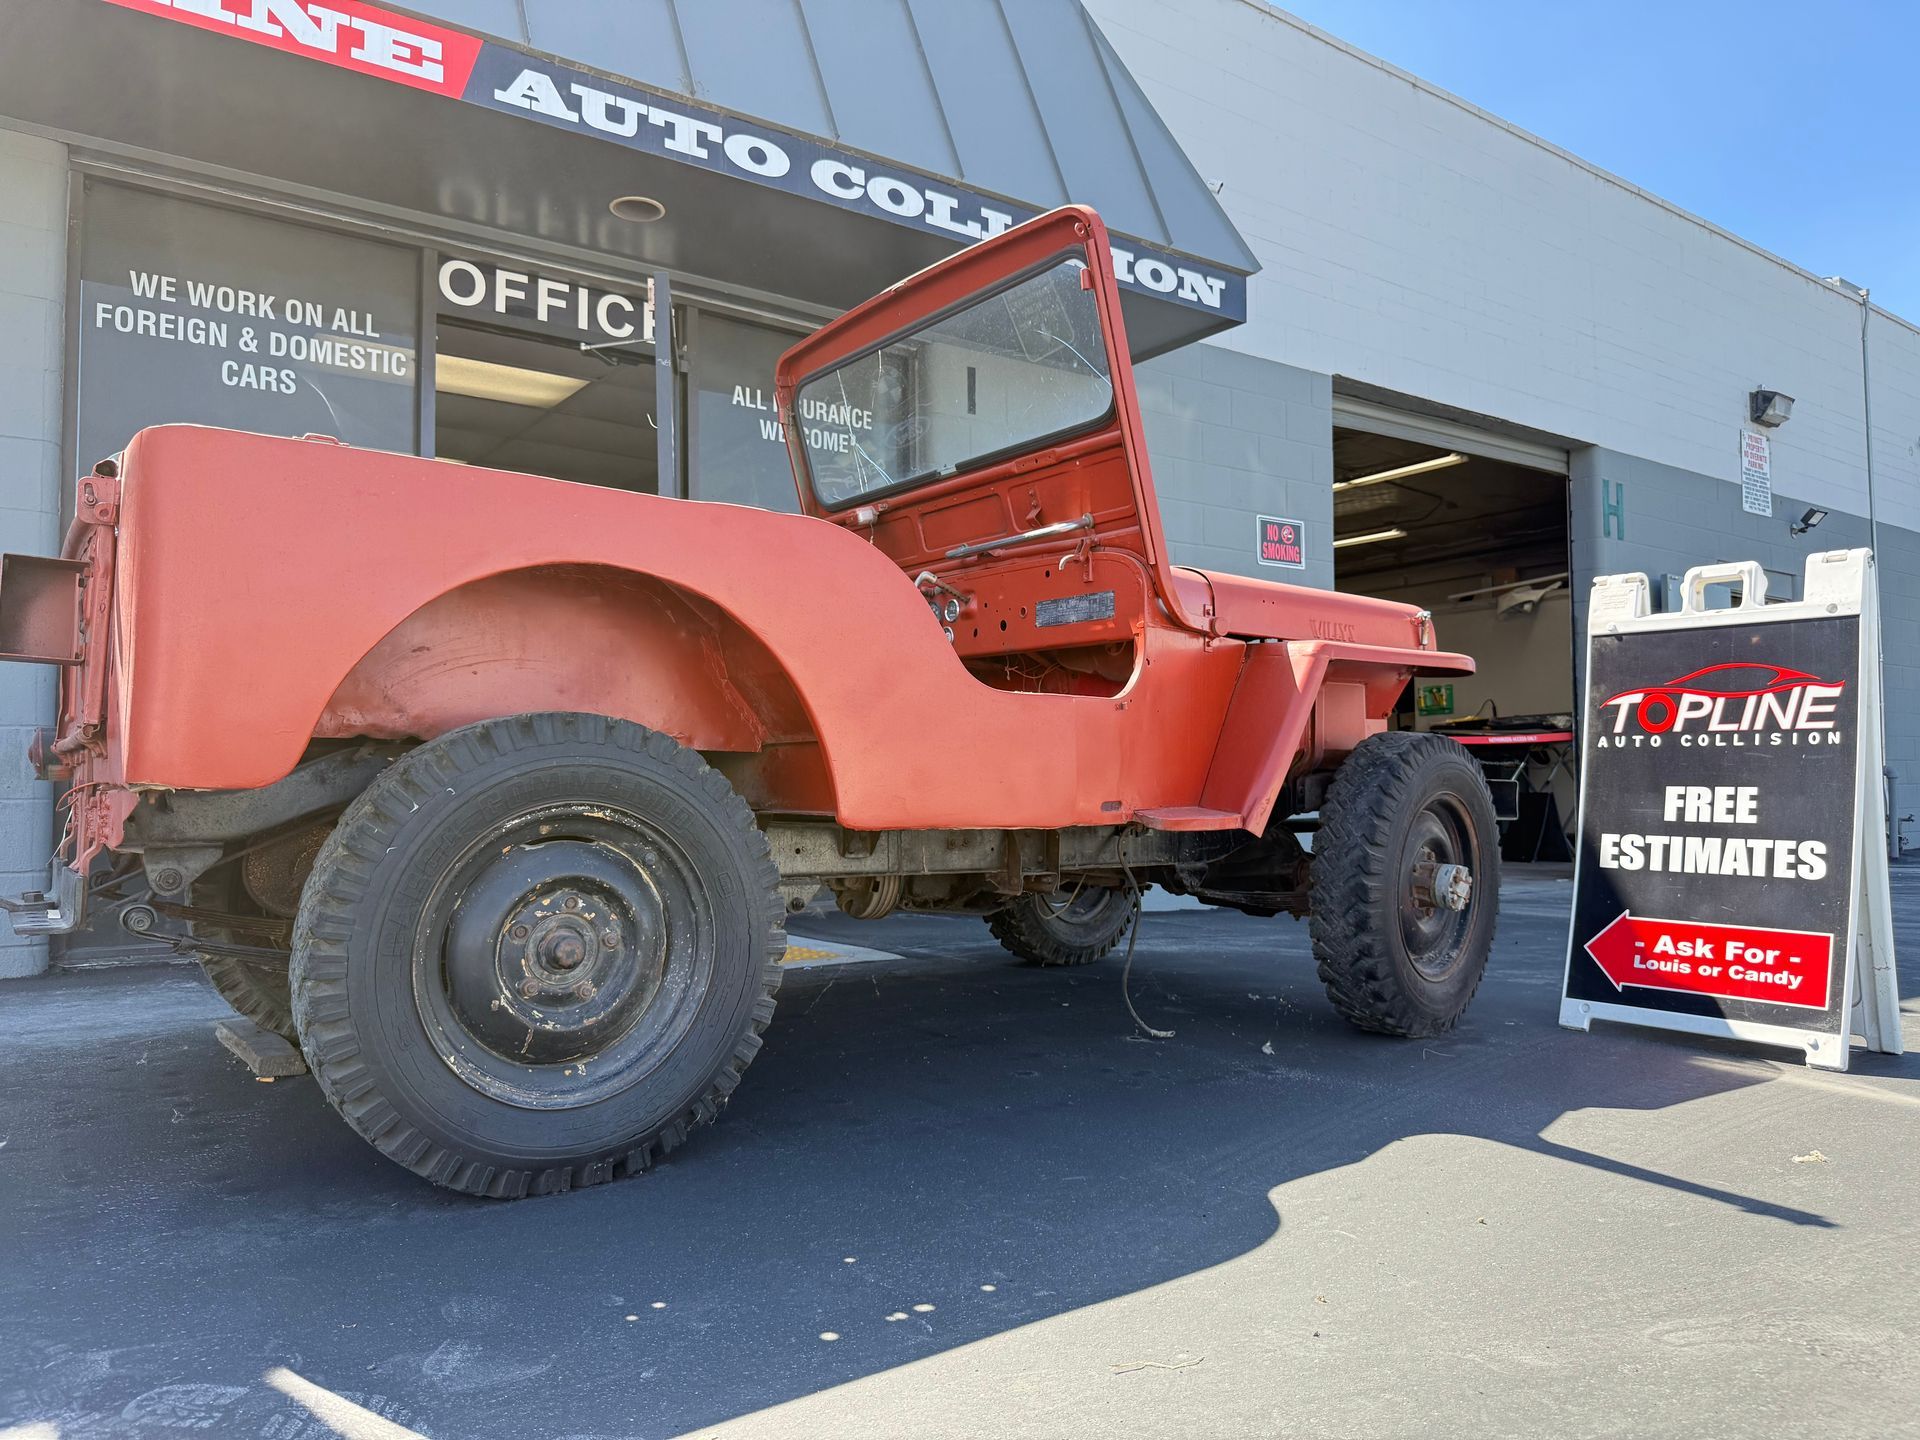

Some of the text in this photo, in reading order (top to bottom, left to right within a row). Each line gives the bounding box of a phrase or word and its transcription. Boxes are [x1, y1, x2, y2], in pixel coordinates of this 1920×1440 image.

[493, 68, 791, 178] AUTO
[810, 158, 1226, 309] COLION
[129, 270, 381, 338] WE WORK ON ALL
[96, 302, 407, 377] FOREIGN & DOMESTIC
[221, 360, 297, 395] CARS
[731, 384, 873, 430] ALL IURANCE
[759, 418, 849, 454] WEOME
[1602, 479, 1624, 540] H
[1263, 541, 1300, 563] SMOKING
[1267, 524, 1279, 541] NO
[1606, 684, 1842, 734] TOPLINE
[1597, 731, 1841, 748] AUTO COLLISION
[1663, 785, 1759, 824] FREE
[1599, 833, 1828, 881] ESTIMATES
[1653, 934, 1715, 959] Ask
[1725, 941, 1781, 965] For
[1634, 954, 1804, 990] Louis or Candy
